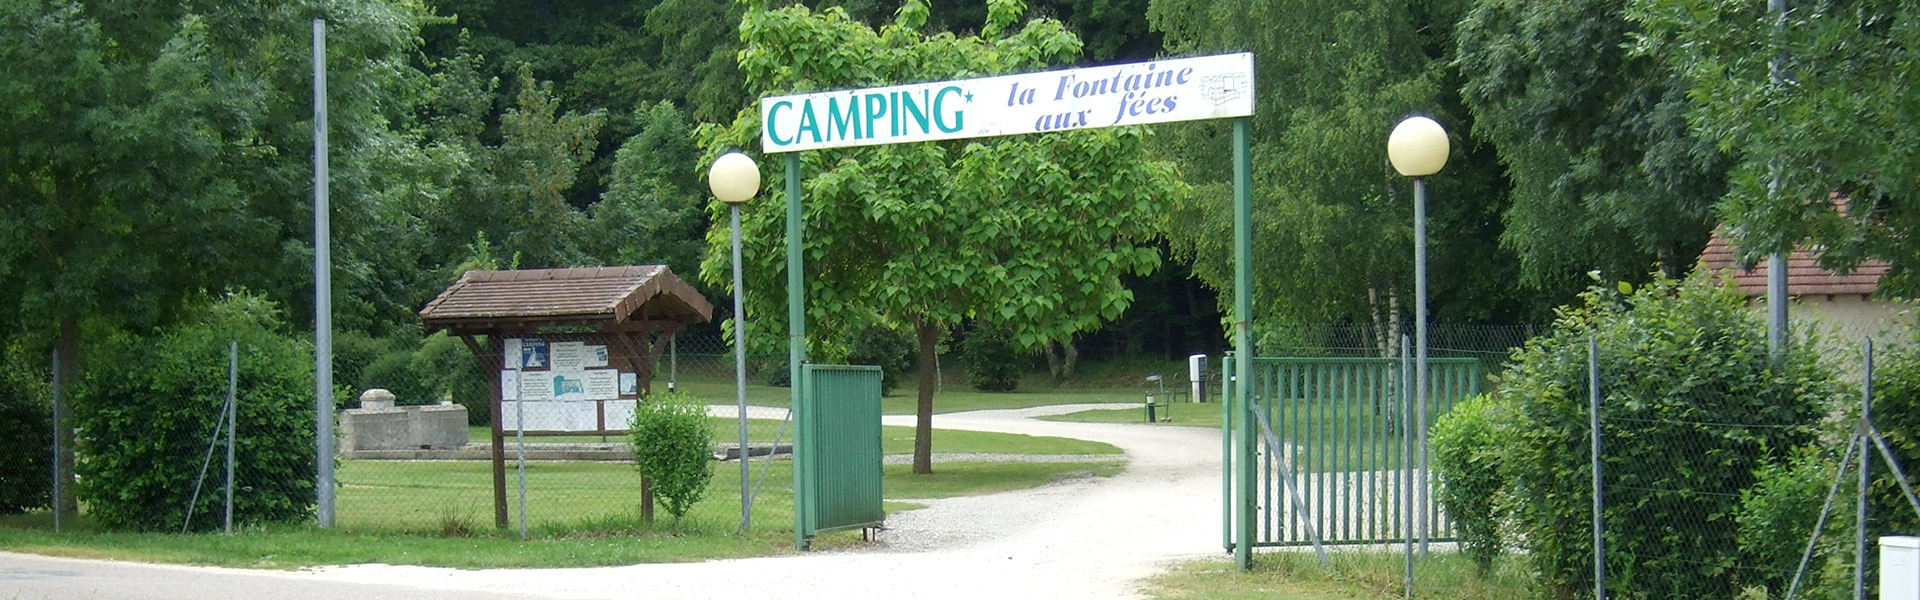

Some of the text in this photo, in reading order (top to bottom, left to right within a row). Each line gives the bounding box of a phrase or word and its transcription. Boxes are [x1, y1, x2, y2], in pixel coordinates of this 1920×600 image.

[1007, 63, 1194, 107] la Fontaine
[767, 86, 964, 146] CAMPING
[1035, 91, 1178, 132] aux fées
